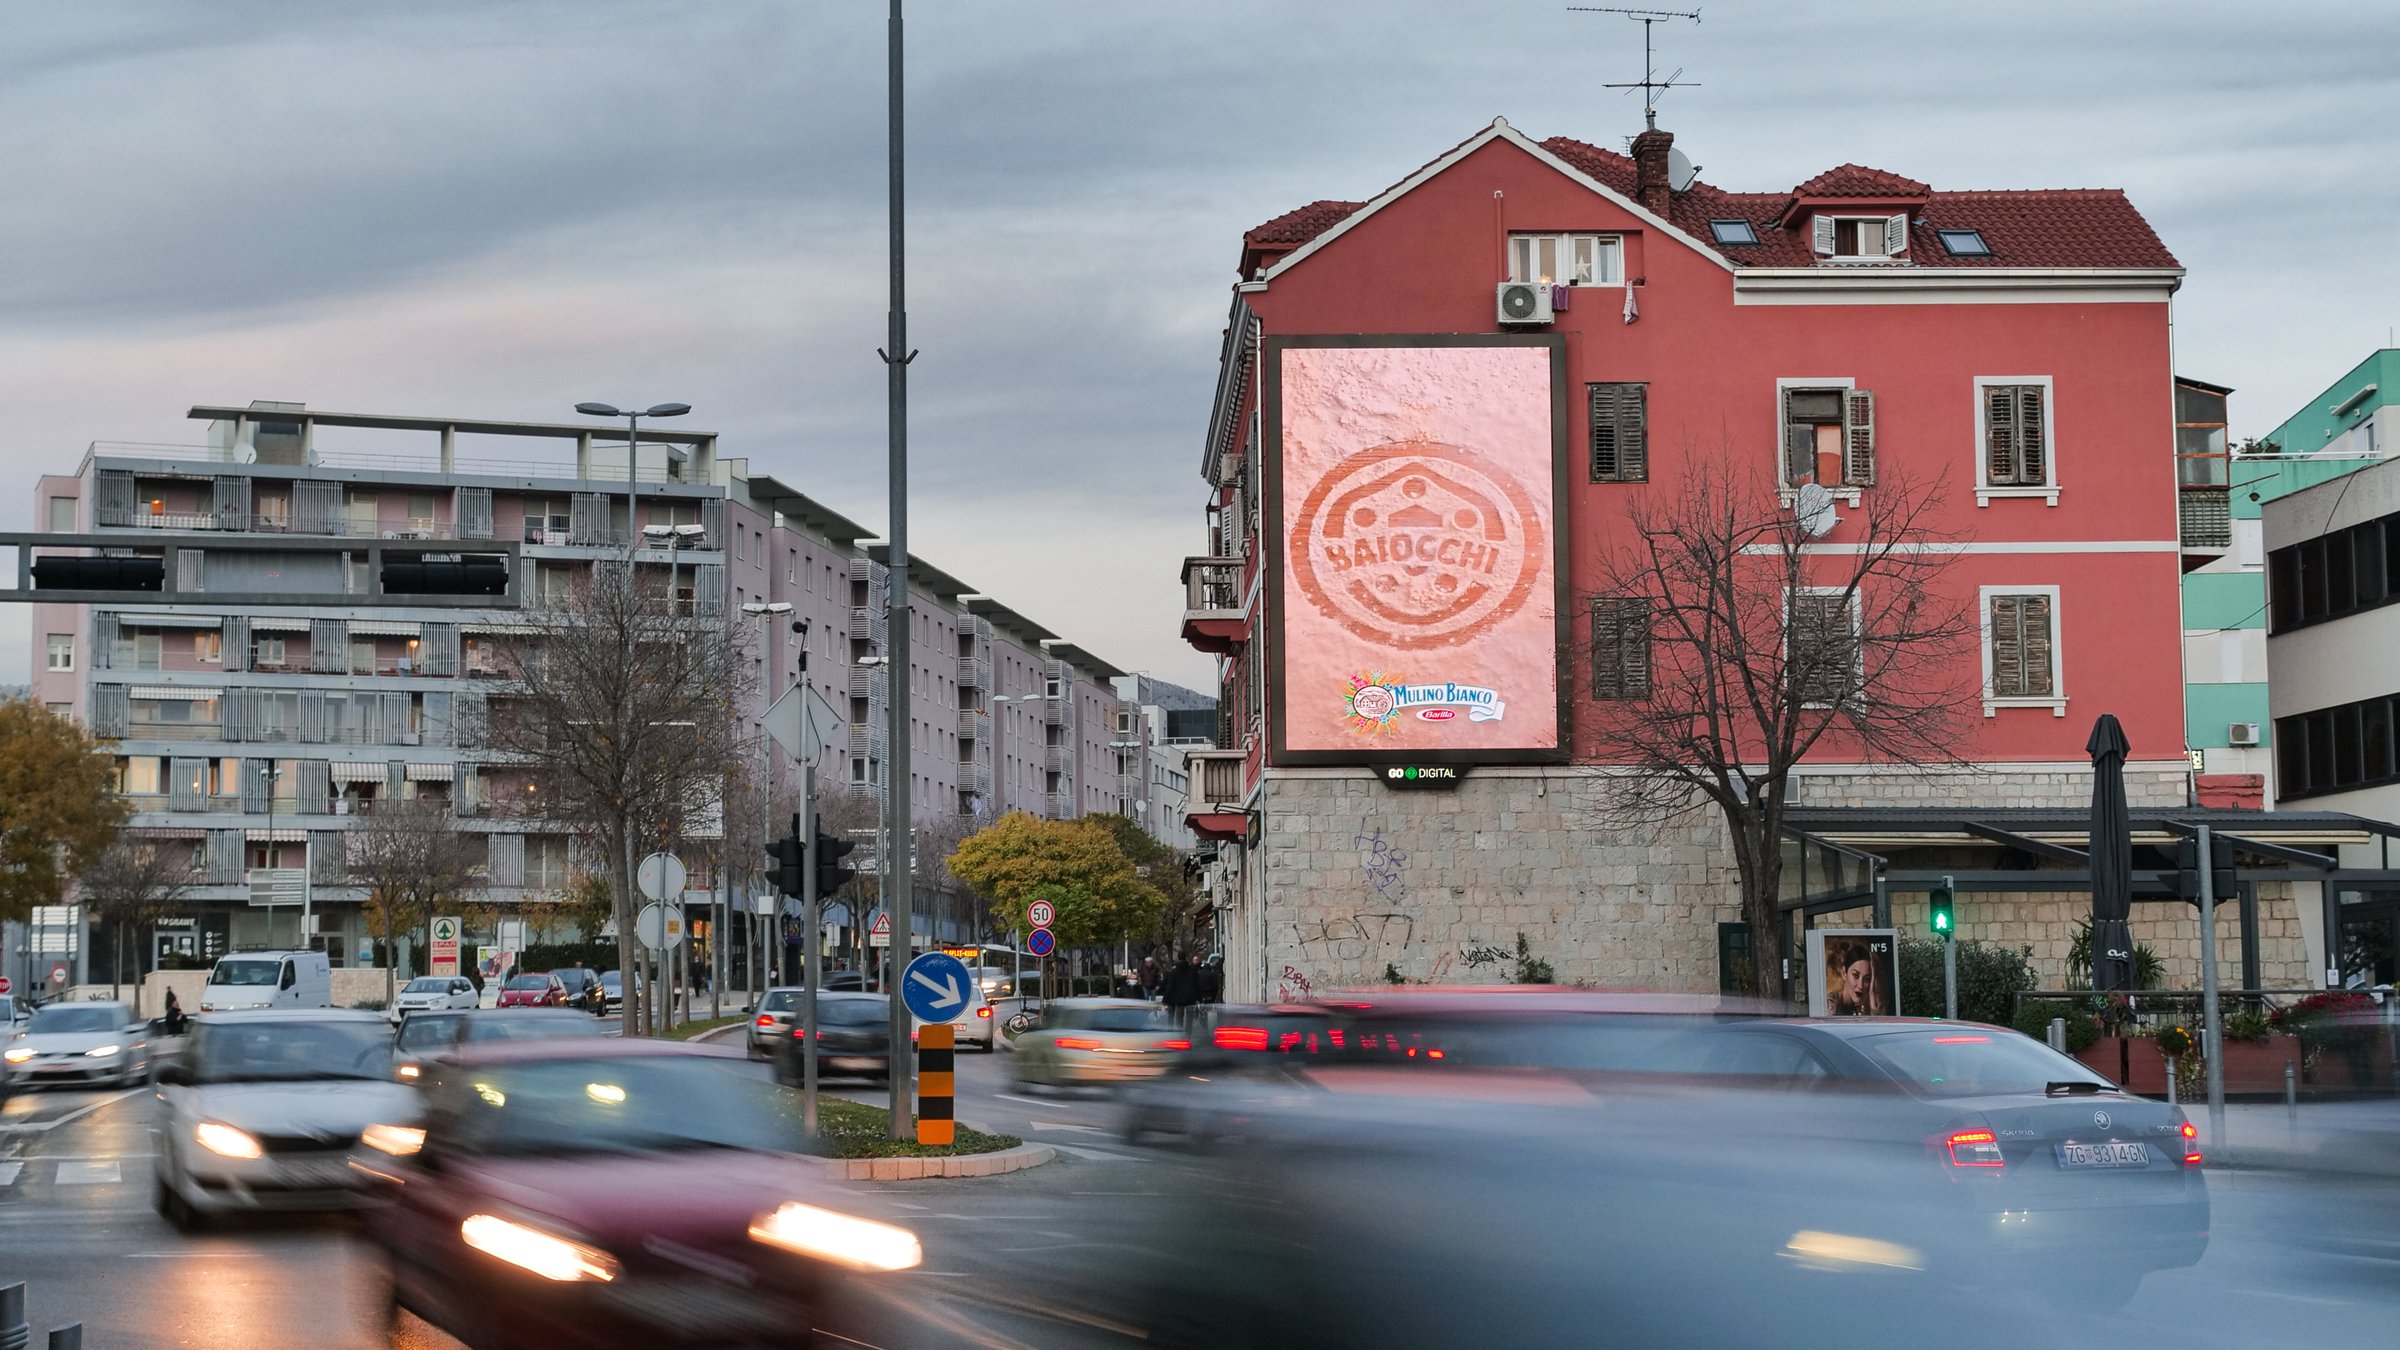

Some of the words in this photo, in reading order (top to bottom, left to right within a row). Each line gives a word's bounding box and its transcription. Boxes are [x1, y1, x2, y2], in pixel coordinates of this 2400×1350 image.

[1325, 533, 1500, 574] BAIOCCHI
[1394, 684, 1444, 705] MULINO
[1446, 682, 1493, 704] BIANCO
[1388, 768, 1404, 778] GO
[1418, 768, 1456, 778] DIGITAL
[1033, 907, 1049, 921] 50
[2066, 1146, 2086, 1164] ZG
